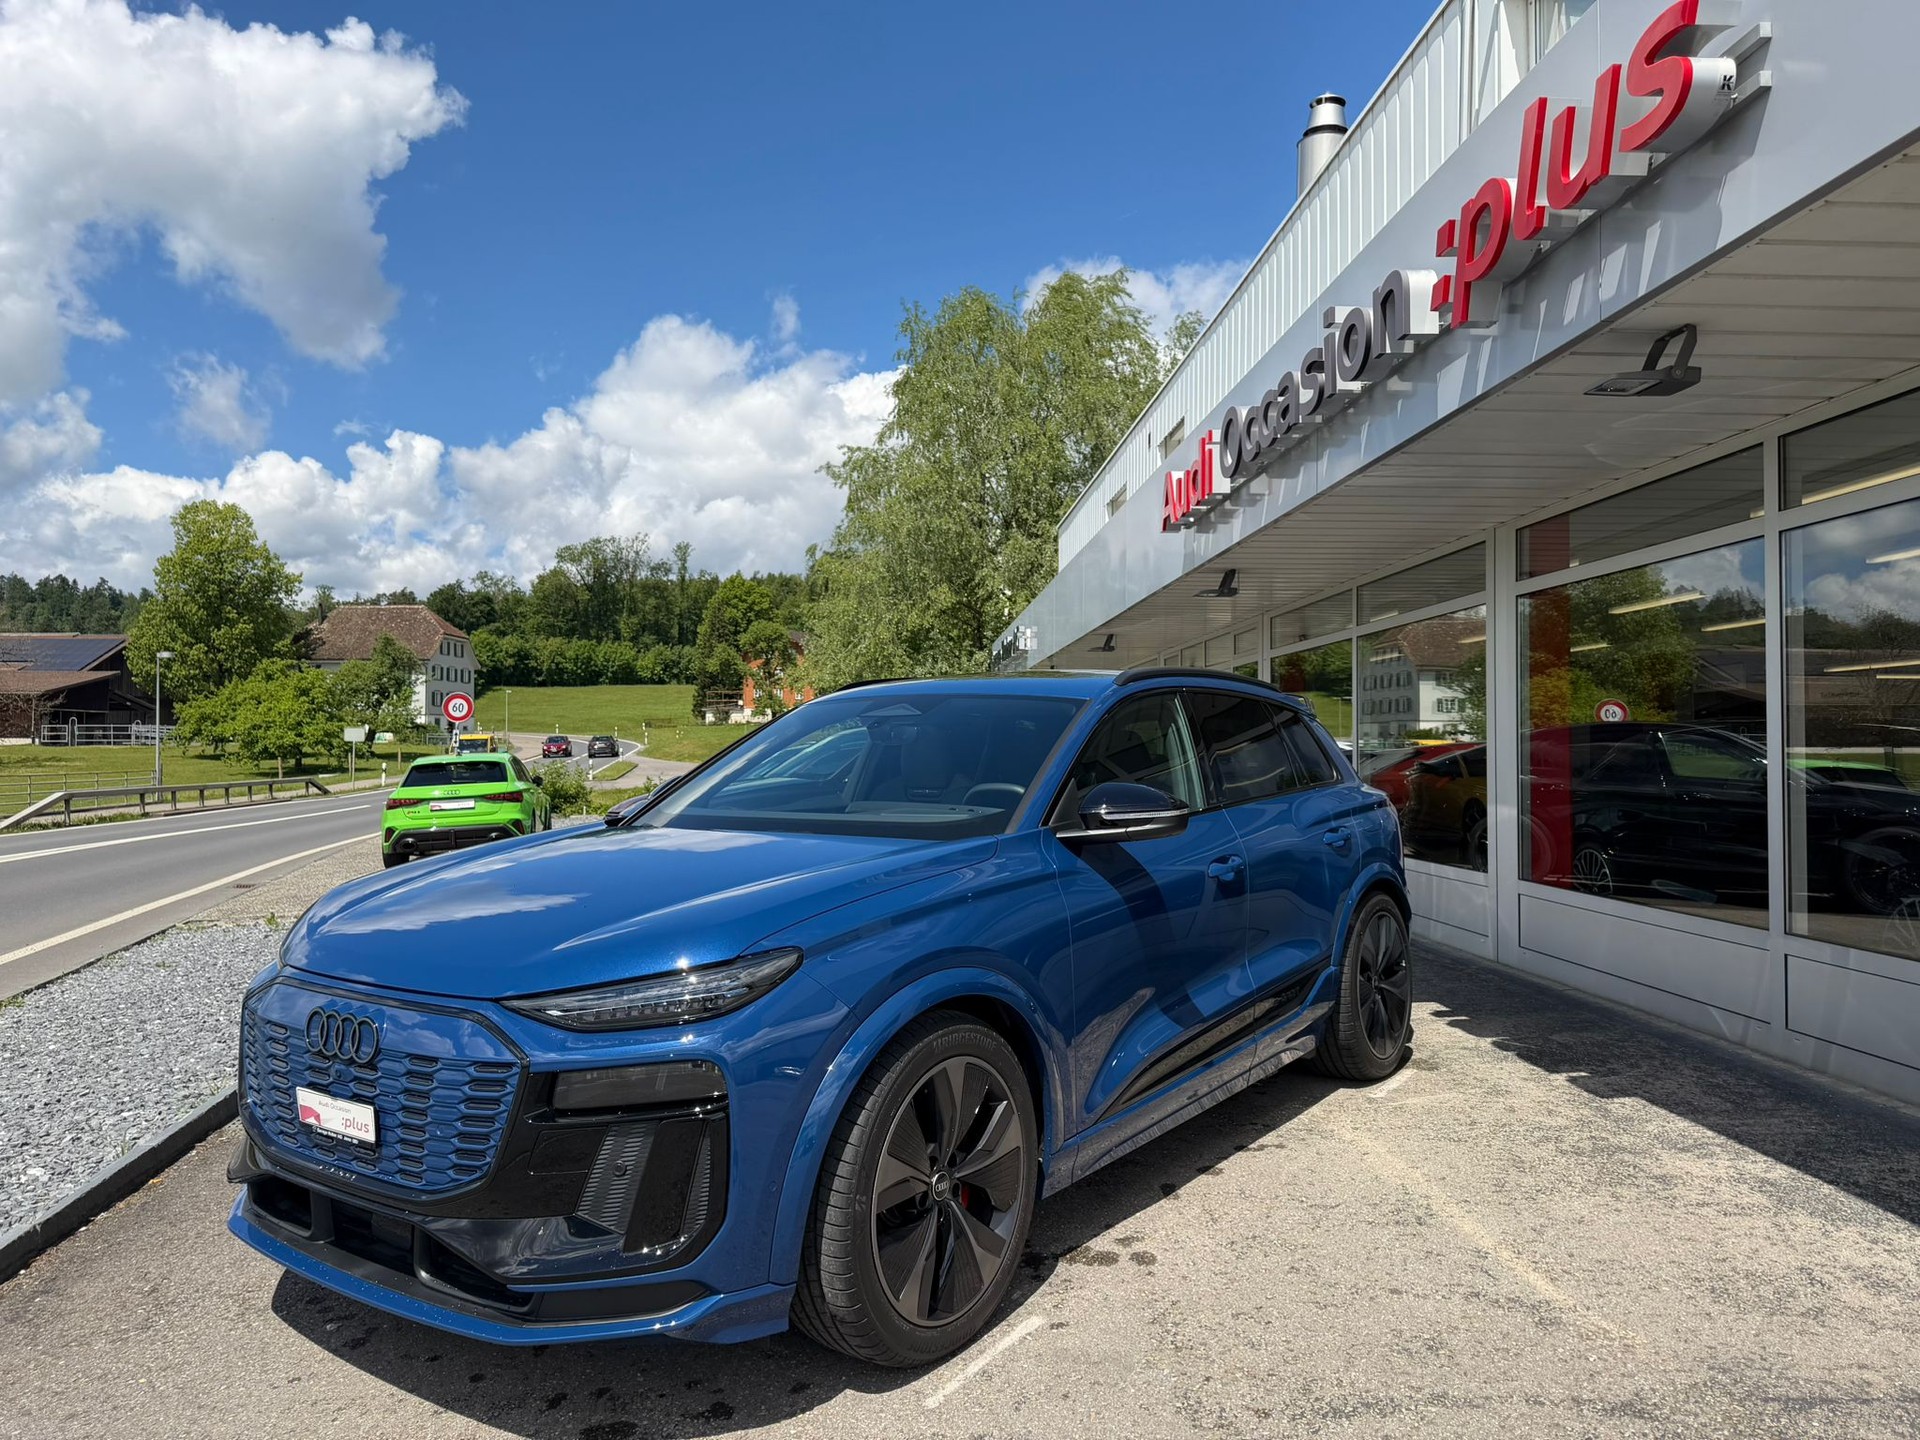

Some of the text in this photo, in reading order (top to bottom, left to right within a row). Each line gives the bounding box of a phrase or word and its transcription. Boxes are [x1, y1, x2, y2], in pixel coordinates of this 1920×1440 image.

[1162, 0, 1699, 532] Audi Occasion :plus
[452, 702, 464, 713] 60
[341, 1116, 370, 1134] :plus
